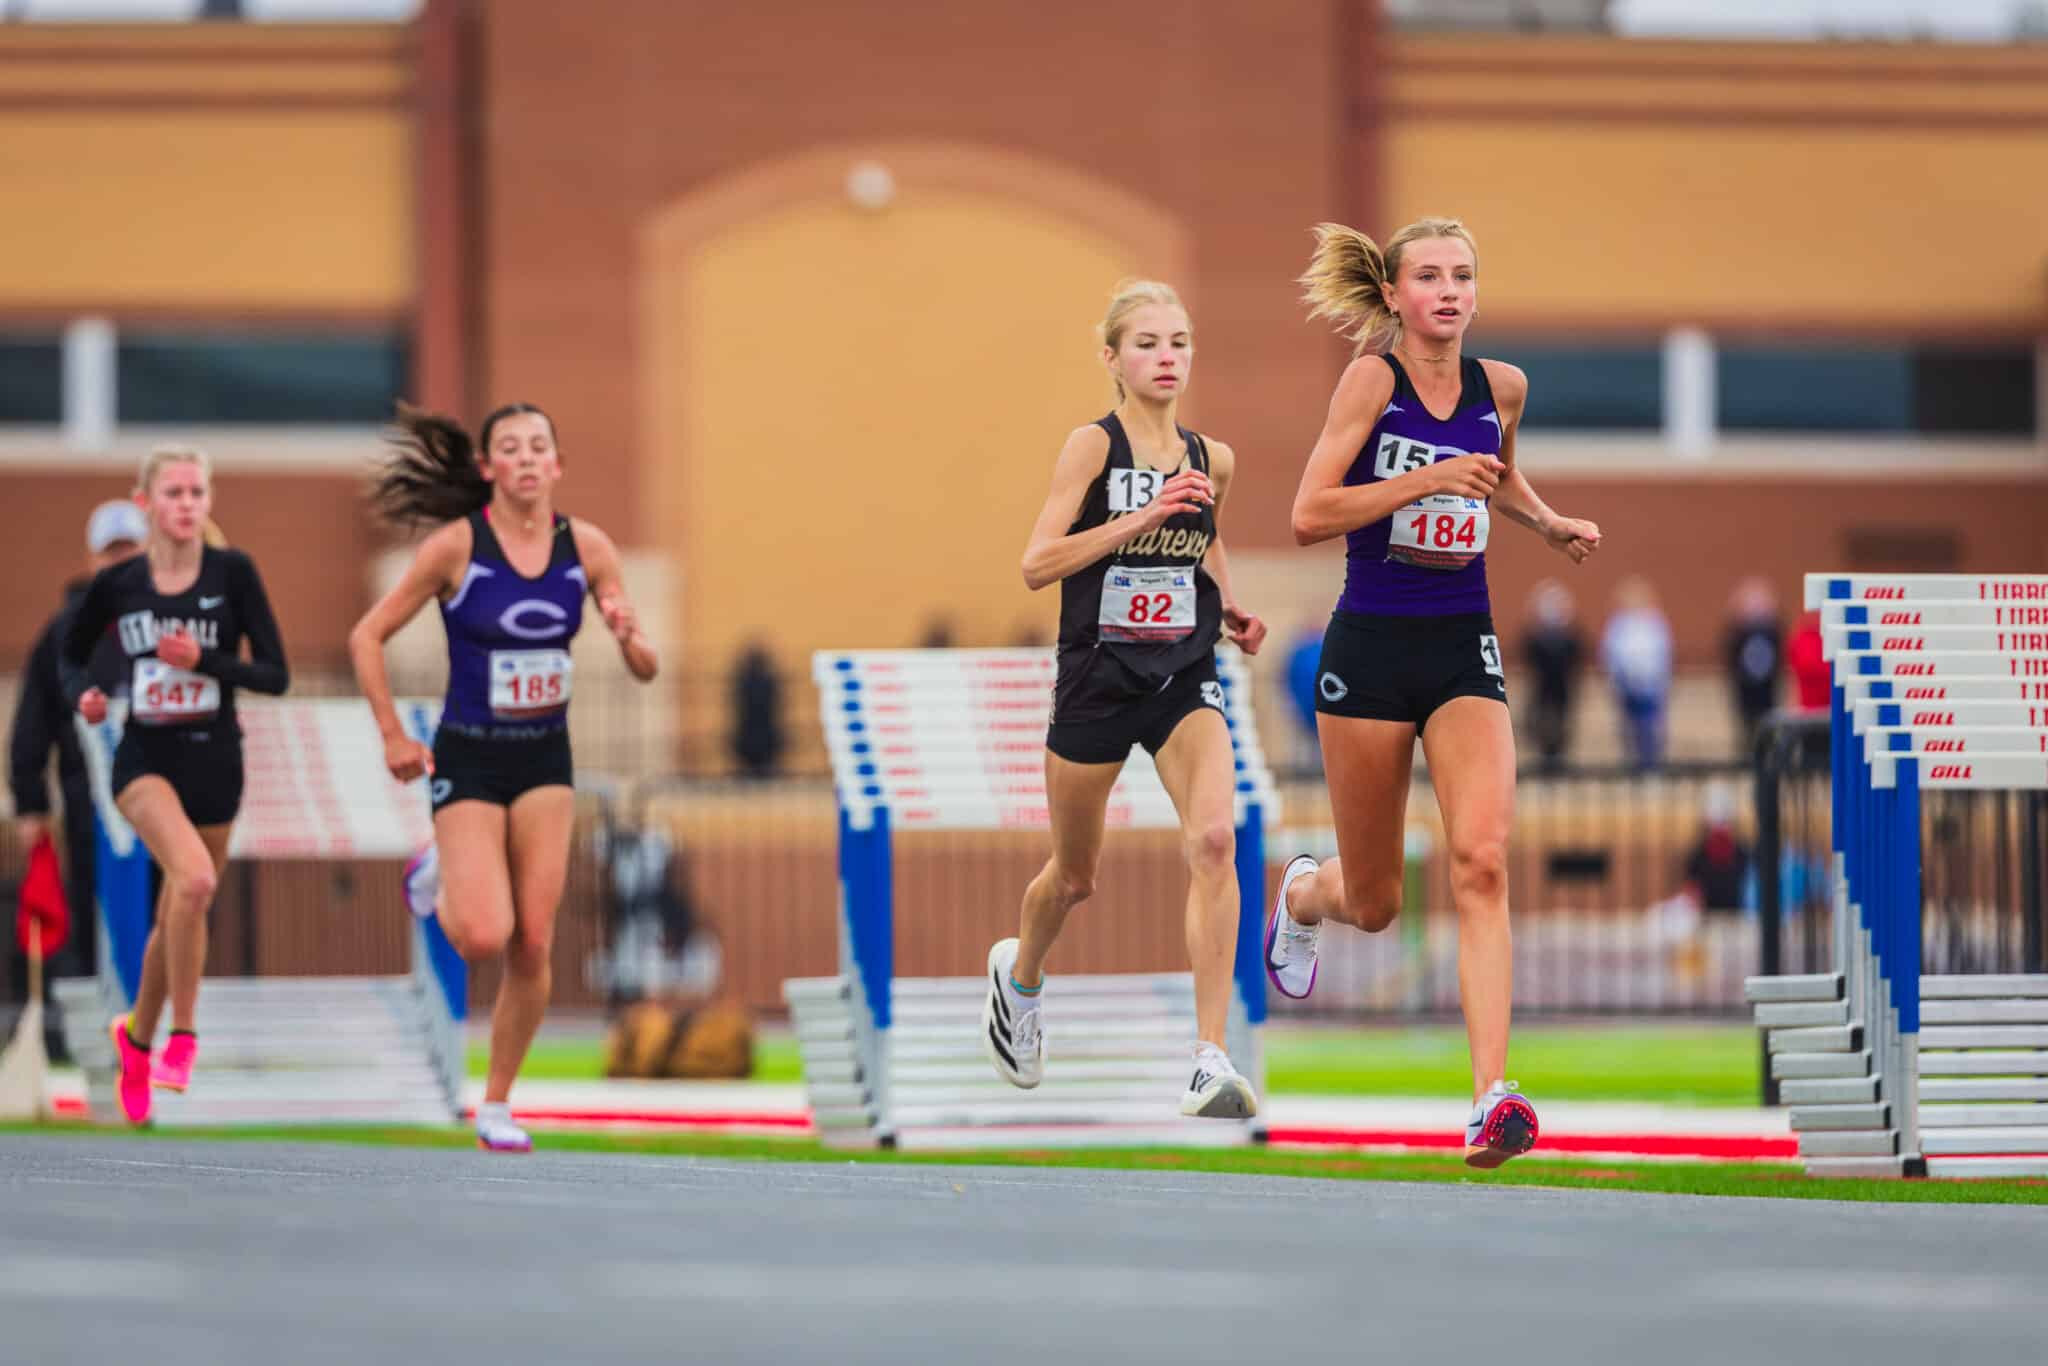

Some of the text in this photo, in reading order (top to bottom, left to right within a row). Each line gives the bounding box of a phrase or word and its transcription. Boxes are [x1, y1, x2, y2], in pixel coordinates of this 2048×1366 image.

[1381, 439, 1429, 473] 15
[1119, 471, 1154, 508] 13
[1410, 513, 1476, 548] 184
[1864, 587, 1905, 600] GILL
[1127, 592, 1173, 623] 82
[1880, 612, 1921, 625] GILL
[1883, 638, 1924, 651] GILL
[1894, 663, 1935, 676] GILL
[145, 681, 205, 708] 547
[504, 673, 562, 704] 185
[1905, 687, 1946, 699] GILL
[1913, 712, 1954, 726] GILL
[1924, 740, 1965, 752] GILL
[1930, 765, 1972, 779] GILL
